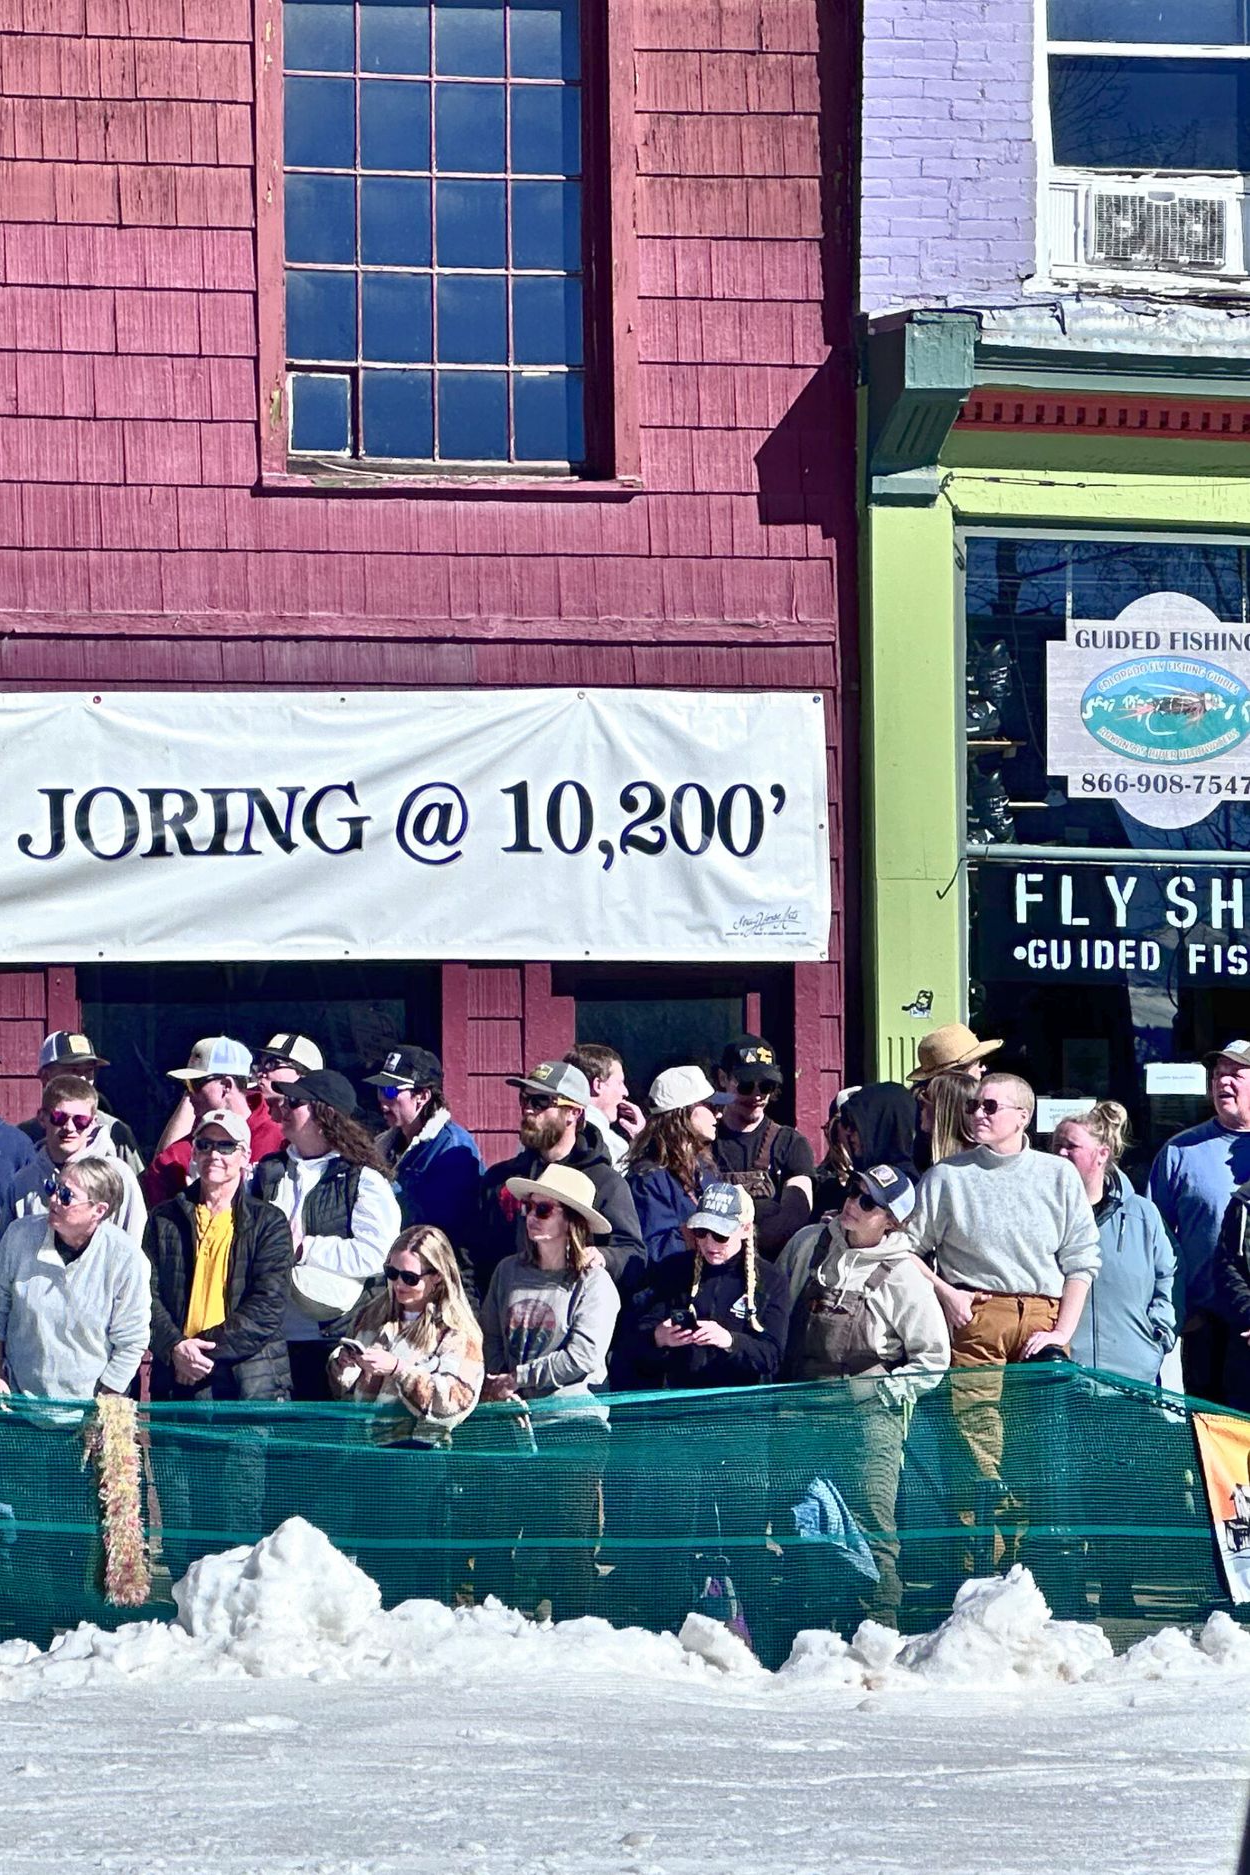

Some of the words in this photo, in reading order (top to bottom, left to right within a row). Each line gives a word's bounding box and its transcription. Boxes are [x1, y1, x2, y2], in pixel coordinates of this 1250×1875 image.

[1075, 630, 1161, 650] GUIDED
[1097, 663, 1148, 693] COLORADO
[1149, 661, 1167, 673] FLY
[1168, 661, 1207, 678] FISHING
[1206, 670, 1240, 695] GUIDES
[1081, 773, 1250, 795] 866-908-7547
[17, 780, 372, 861] JORING
[395, 781, 469, 865] @
[1015, 873, 1138, 928] FLY
